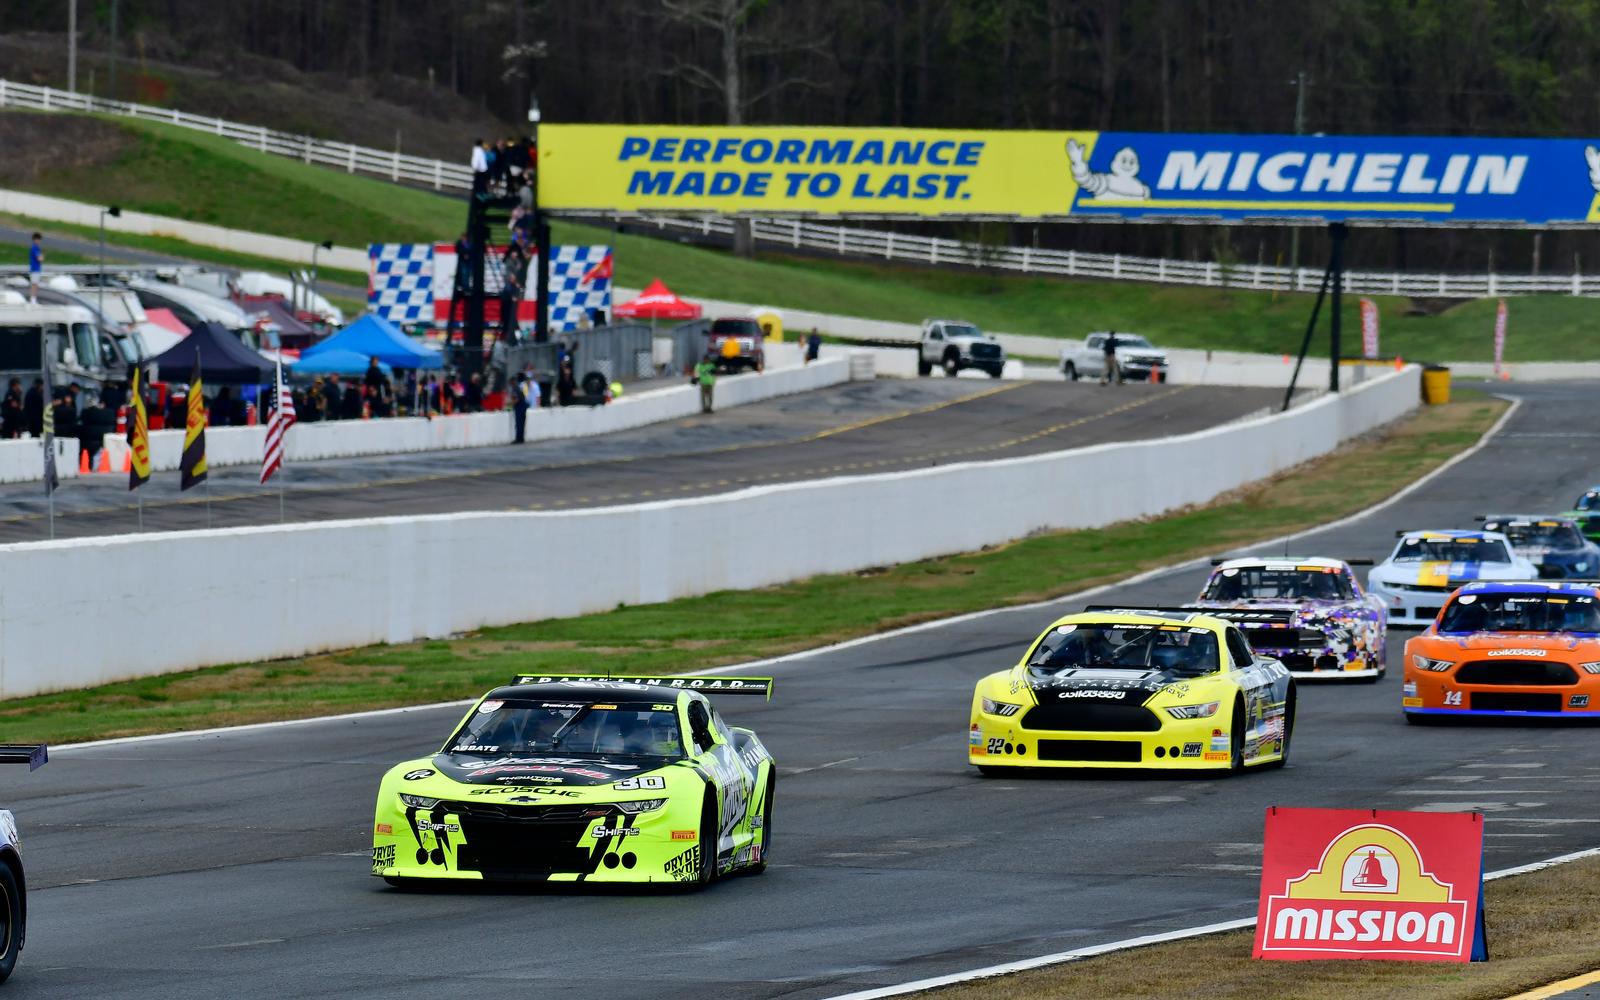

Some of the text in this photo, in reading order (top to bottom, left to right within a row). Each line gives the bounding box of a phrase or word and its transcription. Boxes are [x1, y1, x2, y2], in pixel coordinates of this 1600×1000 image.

[618, 137, 985, 166] PERFORMANCE
[1157, 151, 1528, 194] MICHELIN
[626, 171, 971, 200] MADE TO LAST.
[1443, 691, 1462, 706] 14
[987, 738, 1005, 754] 22
[469, 786, 586, 798] SCOSCHE
[614, 776, 666, 790] 30
[664, 844, 700, 873] PRYDE
